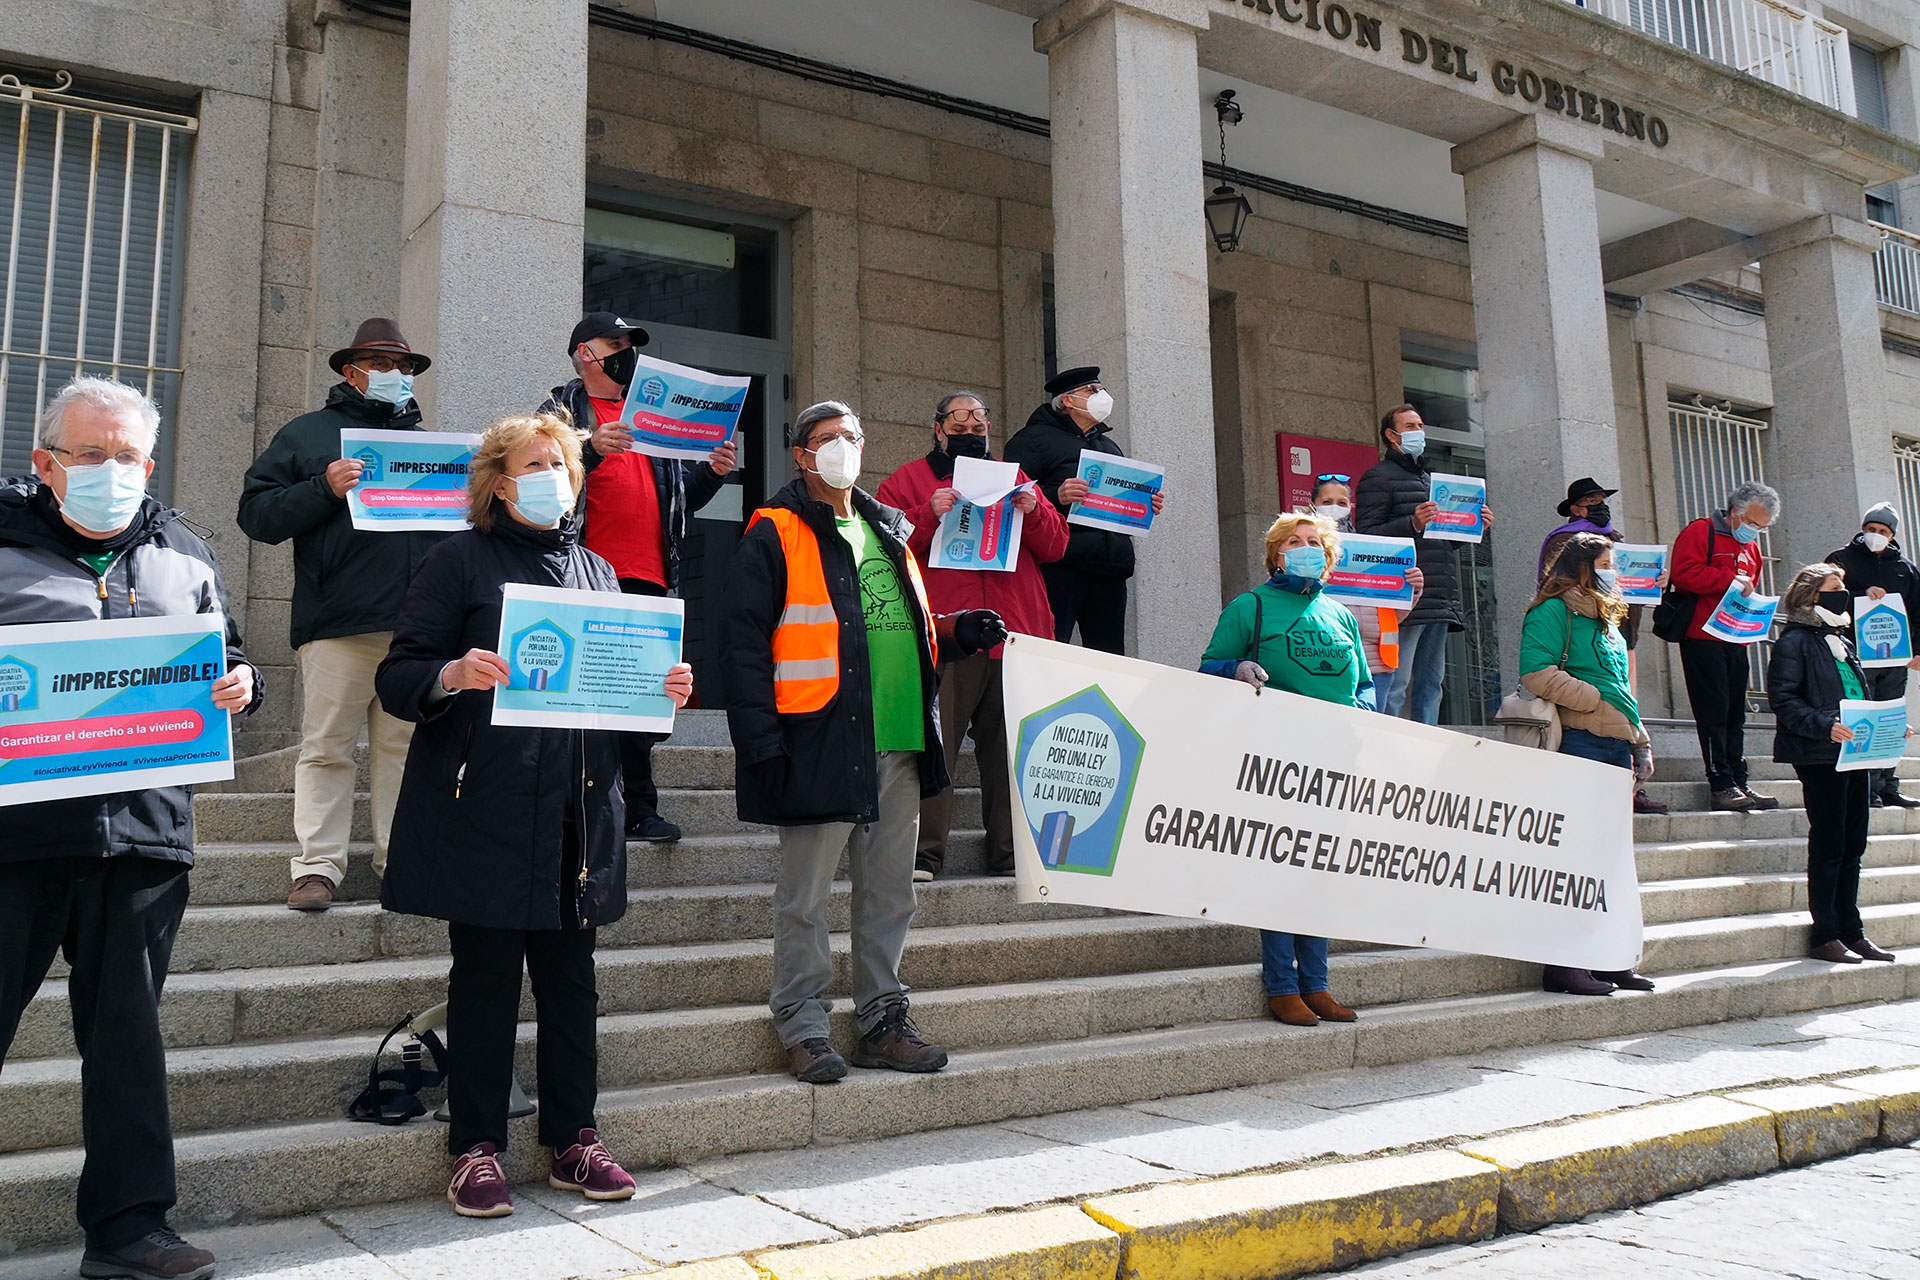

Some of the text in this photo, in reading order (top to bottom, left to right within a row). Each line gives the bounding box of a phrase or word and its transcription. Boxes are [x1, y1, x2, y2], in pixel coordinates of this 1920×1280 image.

[1400, 28, 1478, 82] DEL
[1491, 60, 1669, 148] GOBIERNO
[671, 393, 740, 412] ¡IMPRESCINDIBLE!
[641, 417, 662, 427] Parque
[662, 423, 681, 431] público
[390, 461, 472, 475] ¡IMPRESCINDIB
[1352, 553, 1413, 566] ¡IMPRESCINDIBLE!
[529, 635, 557, 643] INICIATIVA
[535, 658, 558, 666] VIVIENDA
[1295, 647, 1348, 659] DESAHUCIOS
[52, 662, 218, 693] ¡IMPRESCINDIBLE!
[1, 720, 194, 747] Garantizar el derecho a la vivienda
[1052, 725, 1109, 750] INICIATIVA
[34, 750, 221, 776] #IniciativaLeyVivienda #ViviendaPorDerecho
[1046, 746, 1107, 770] POR UNA LEY
[1029, 765, 1116, 789] QUE GARANTICE EL DERECHO
[1033, 782, 1102, 807] A LA VIVIENDA
[1236, 753, 1564, 847] INICIATIVA POR UNA LEY QUE
[1144, 804, 1608, 912] GARANTICE EL DERECHO A LA VIVIENDA
